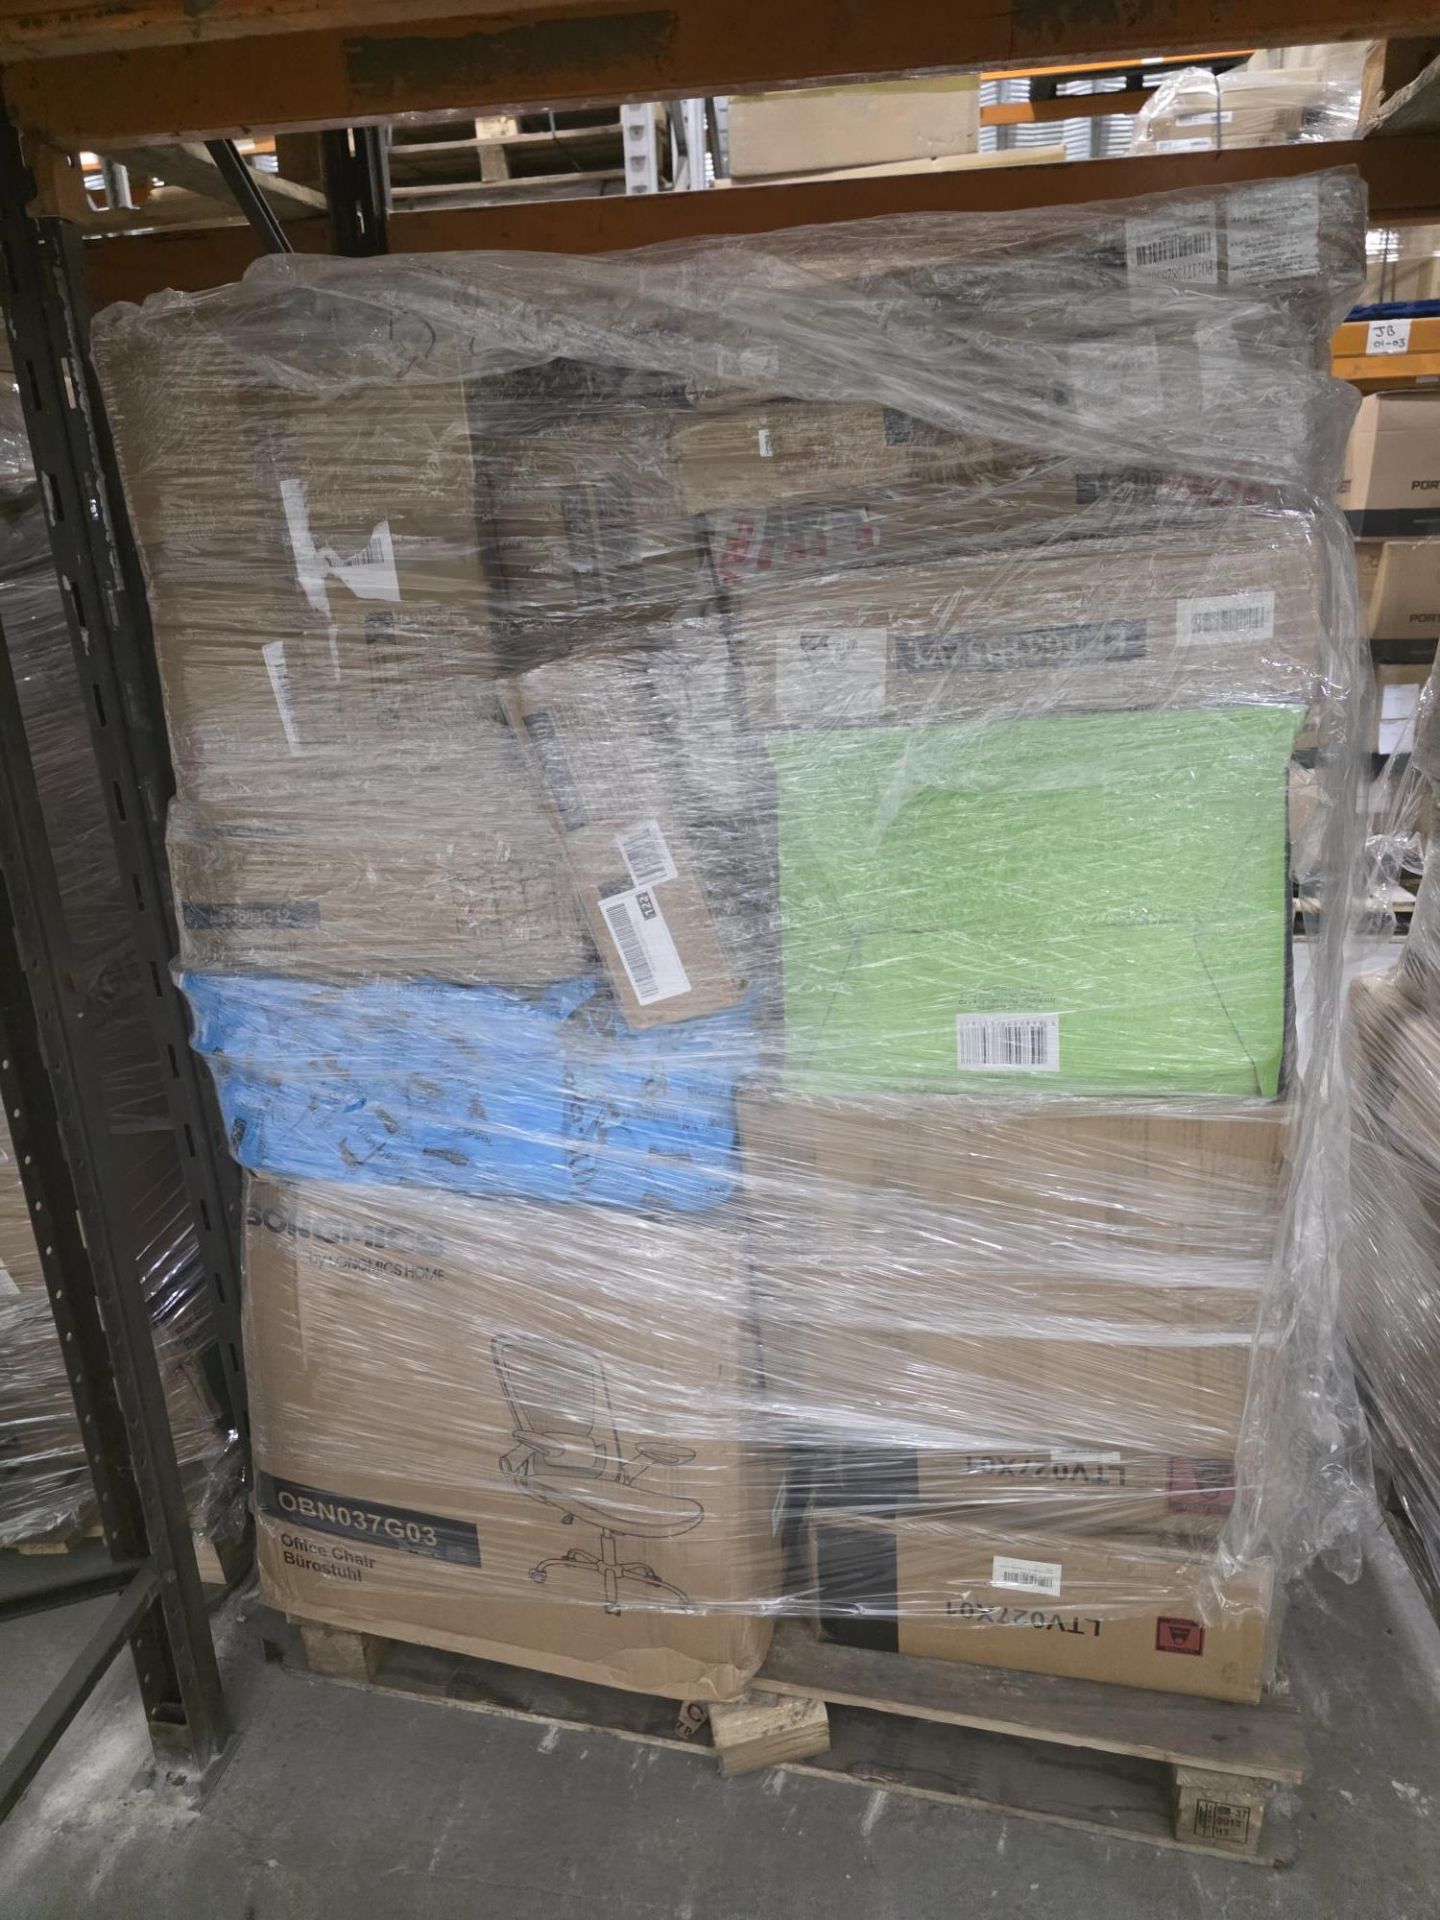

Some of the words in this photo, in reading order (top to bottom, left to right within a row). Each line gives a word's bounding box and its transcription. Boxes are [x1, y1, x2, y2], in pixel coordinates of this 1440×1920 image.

[1373, 325, 1396, 338] JB
[1373, 338, 1406, 348] 01-03
[1411, 480, 1440, 491] POR
[1408, 613, 1440, 624] POR
[404, 1266, 446, 1282] HOME
[278, 1491, 438, 1546] OBN037G03
[281, 1533, 328, 1557] Office
[332, 1546, 376, 1569] Chair
[283, 1550, 363, 1581] Bürostuhl
[945, 1599, 1102, 1638] LTV027X01
